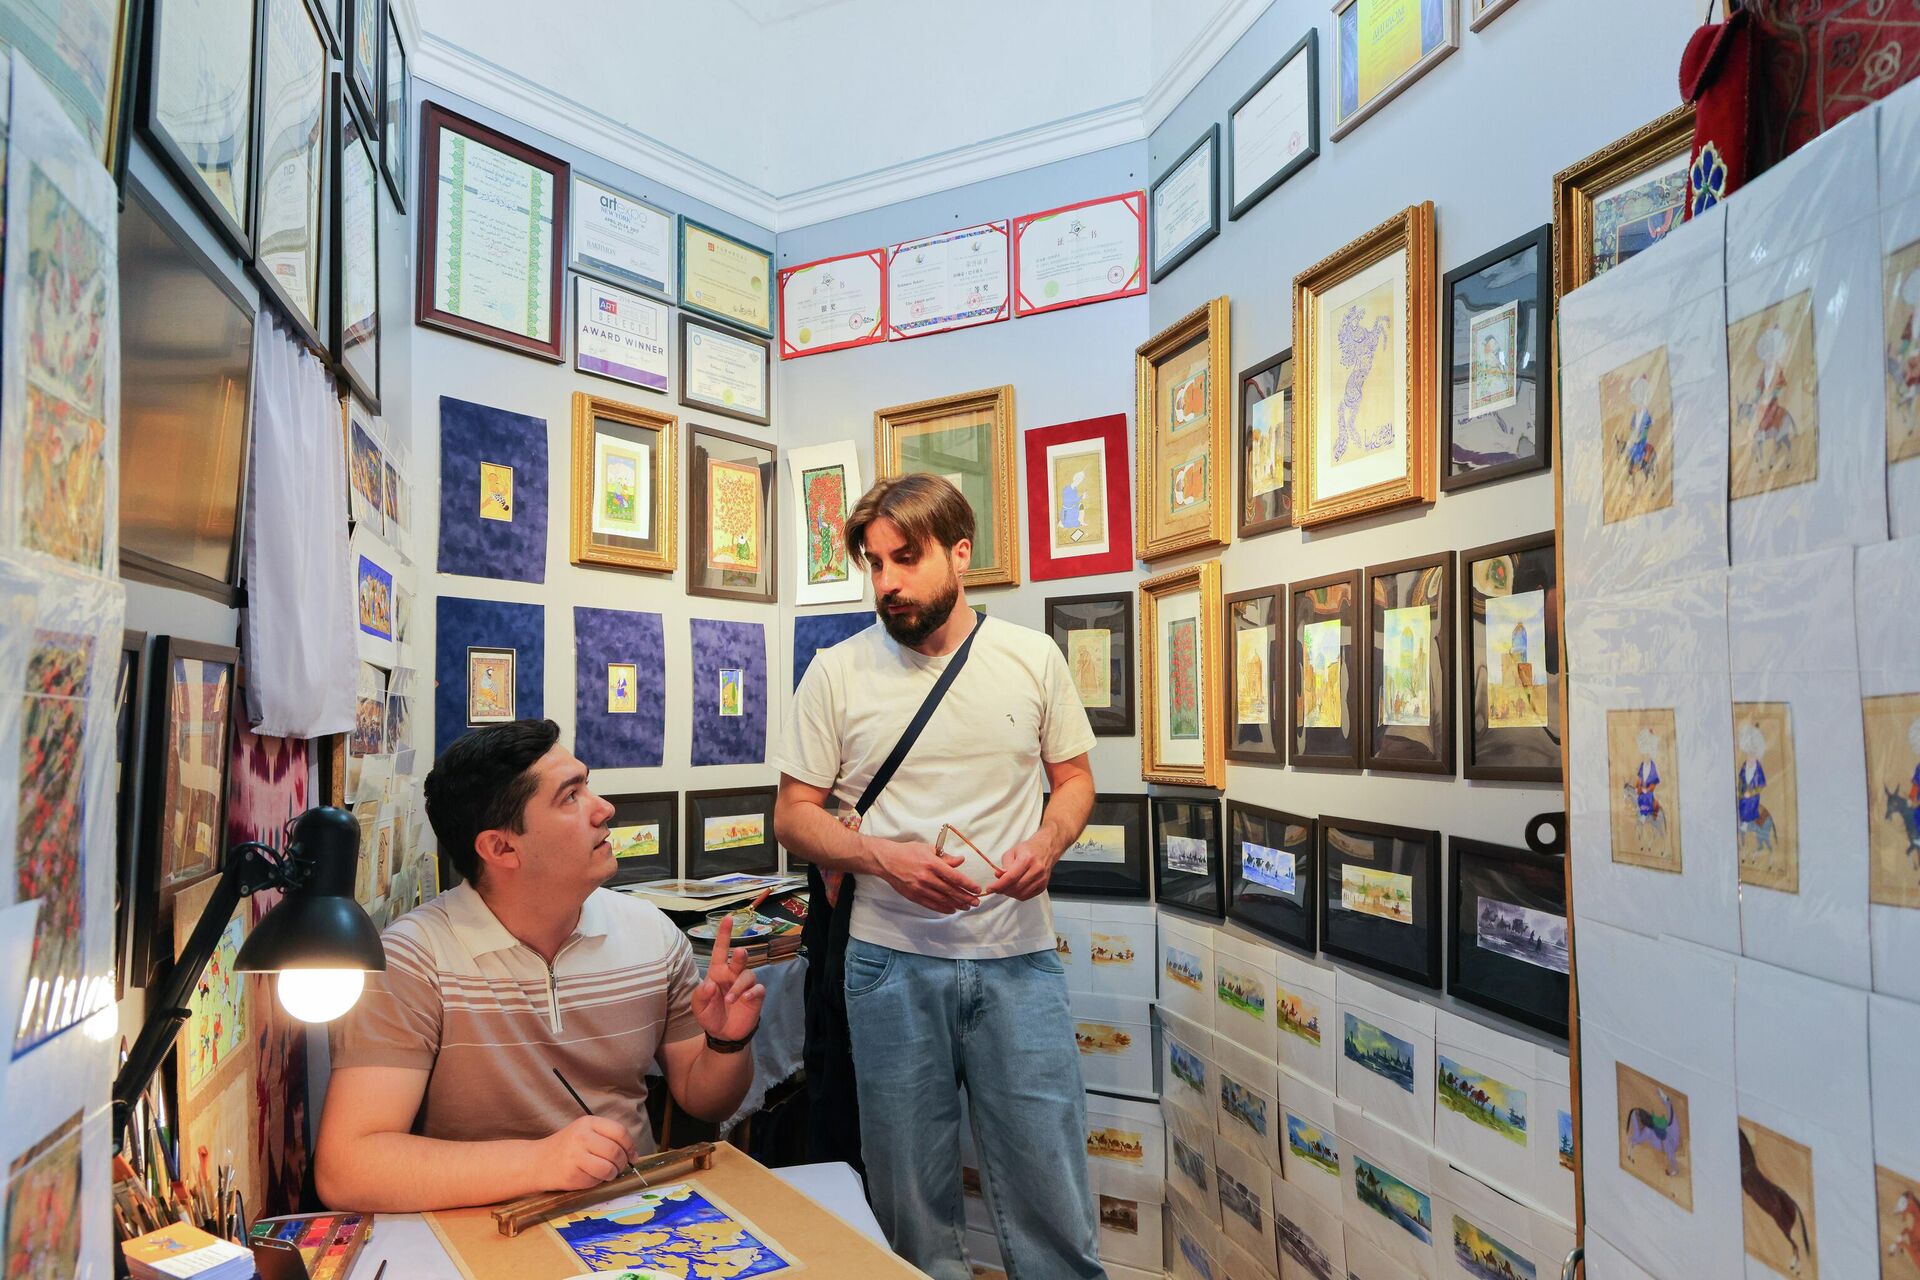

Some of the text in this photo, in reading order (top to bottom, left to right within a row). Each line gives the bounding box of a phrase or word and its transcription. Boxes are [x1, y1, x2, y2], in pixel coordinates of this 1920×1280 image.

[599, 301, 616, 312] ART
[582, 324, 664, 355] AWARD WINNER
